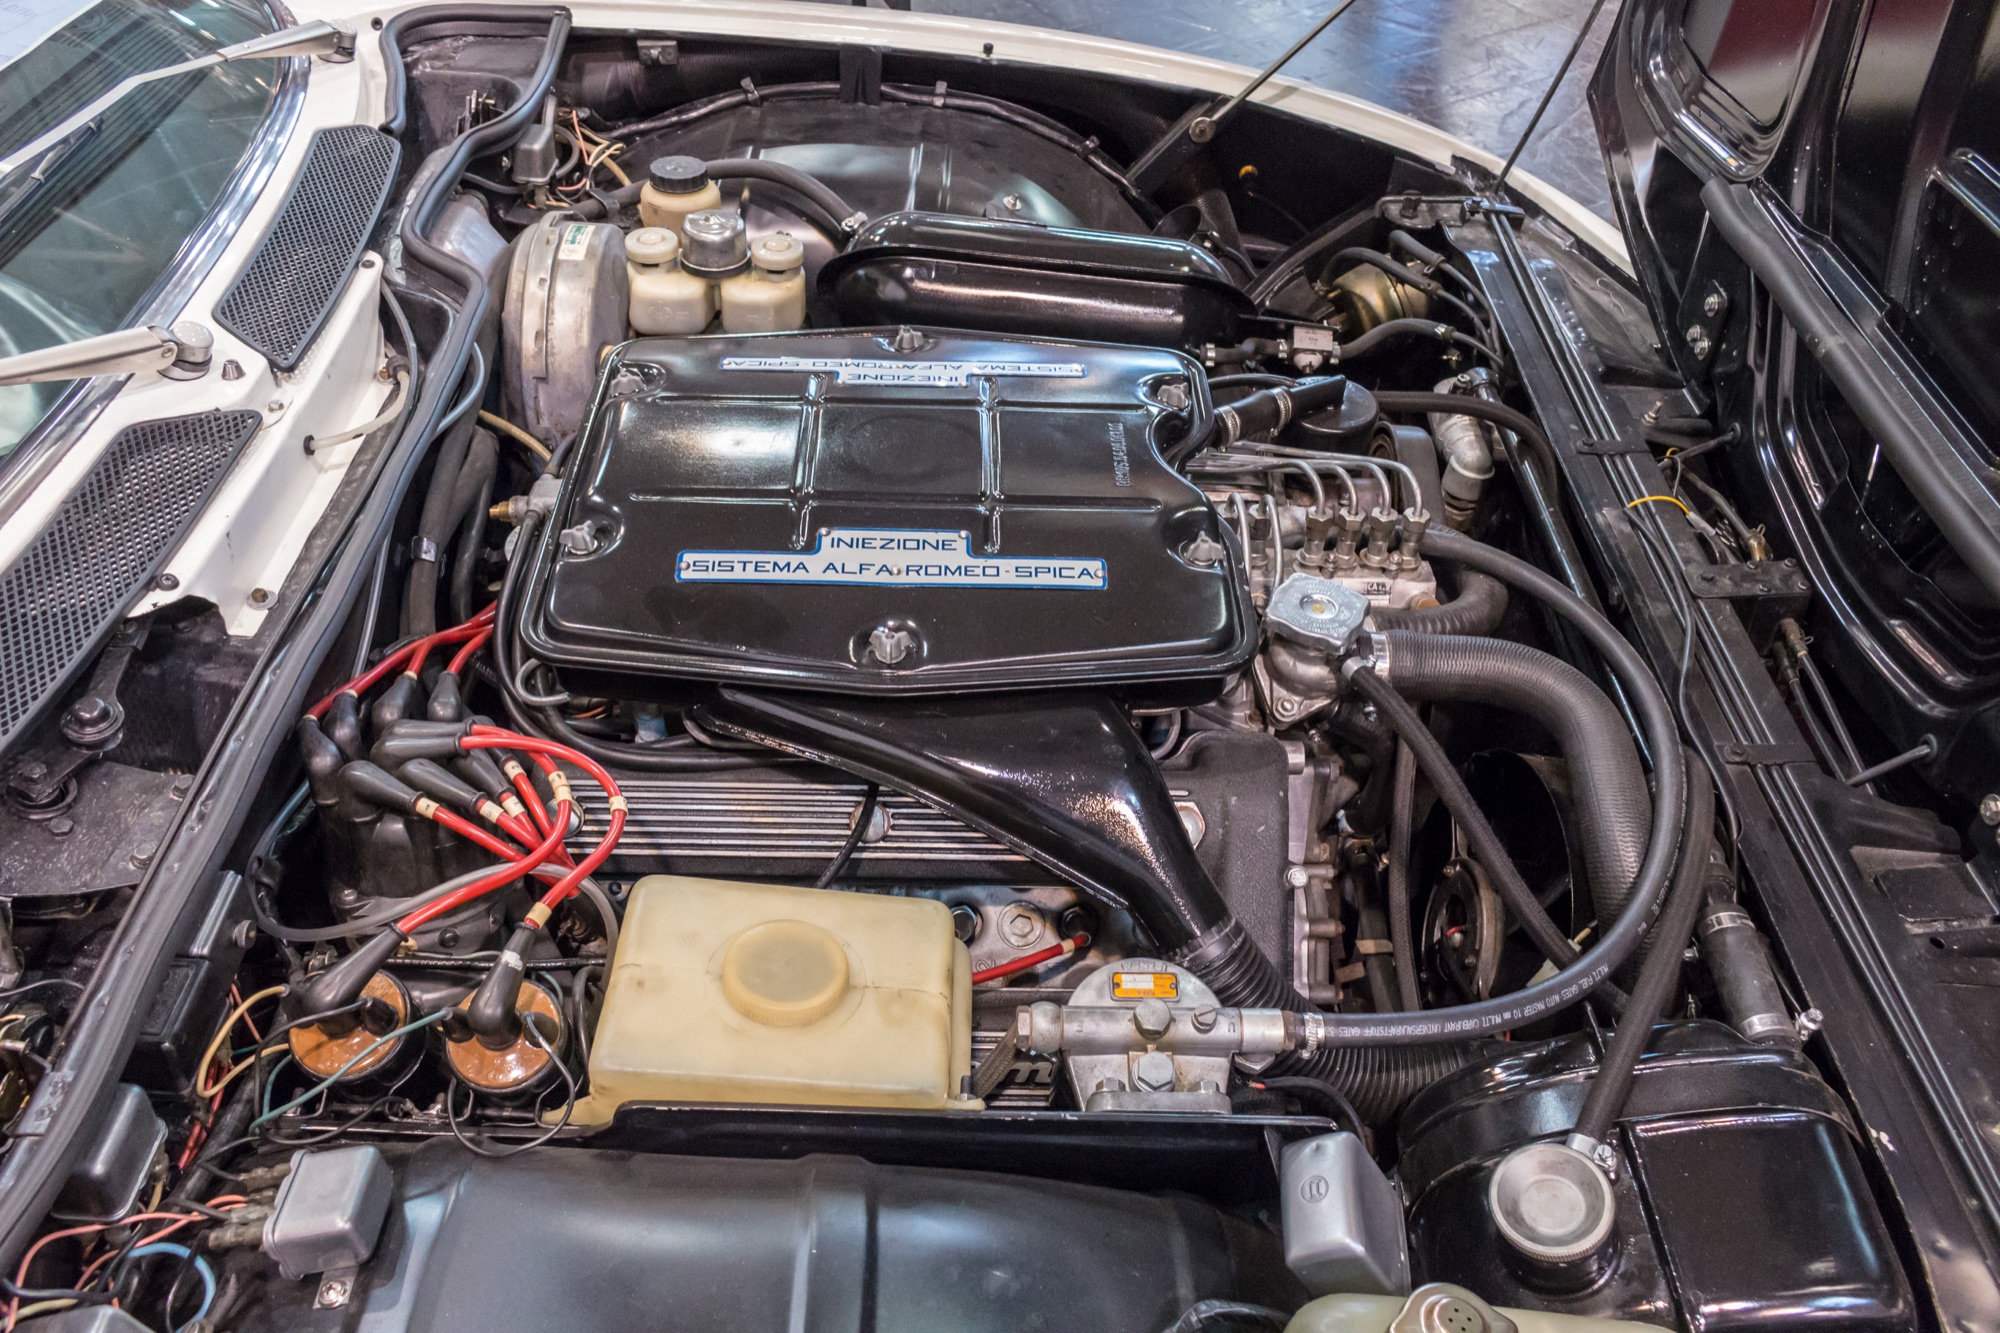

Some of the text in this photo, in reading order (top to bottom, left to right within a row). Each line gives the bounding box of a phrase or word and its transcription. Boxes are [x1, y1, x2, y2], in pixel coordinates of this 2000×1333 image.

[811, 361, 893, 369] ROMEO
[901, 363, 963, 371] ALFA
[847, 373, 959, 383] INIEZIONE
[830, 536, 958, 551] INIEZIONE
[691, 560, 810, 573] SISTEMA
[822, 562, 893, 576] ALFA
[905, 564, 1000, 578] ROMEO
[1594, 963, 1610, 982] MULTI
[1579, 976, 1594, 990] FUEL
[1546, 993, 1560, 1008] AUTO
[1562, 985, 1579, 1001] GATES
[1513, 1009, 1522, 1020] 10
[1524, 1001, 1546, 1017] MASTER
[1444, 1018, 1480, 1033] CARBURANT
[1482, 1013, 1502, 1028] MULTI
[1338, 1026, 1361, 1037] GATES
